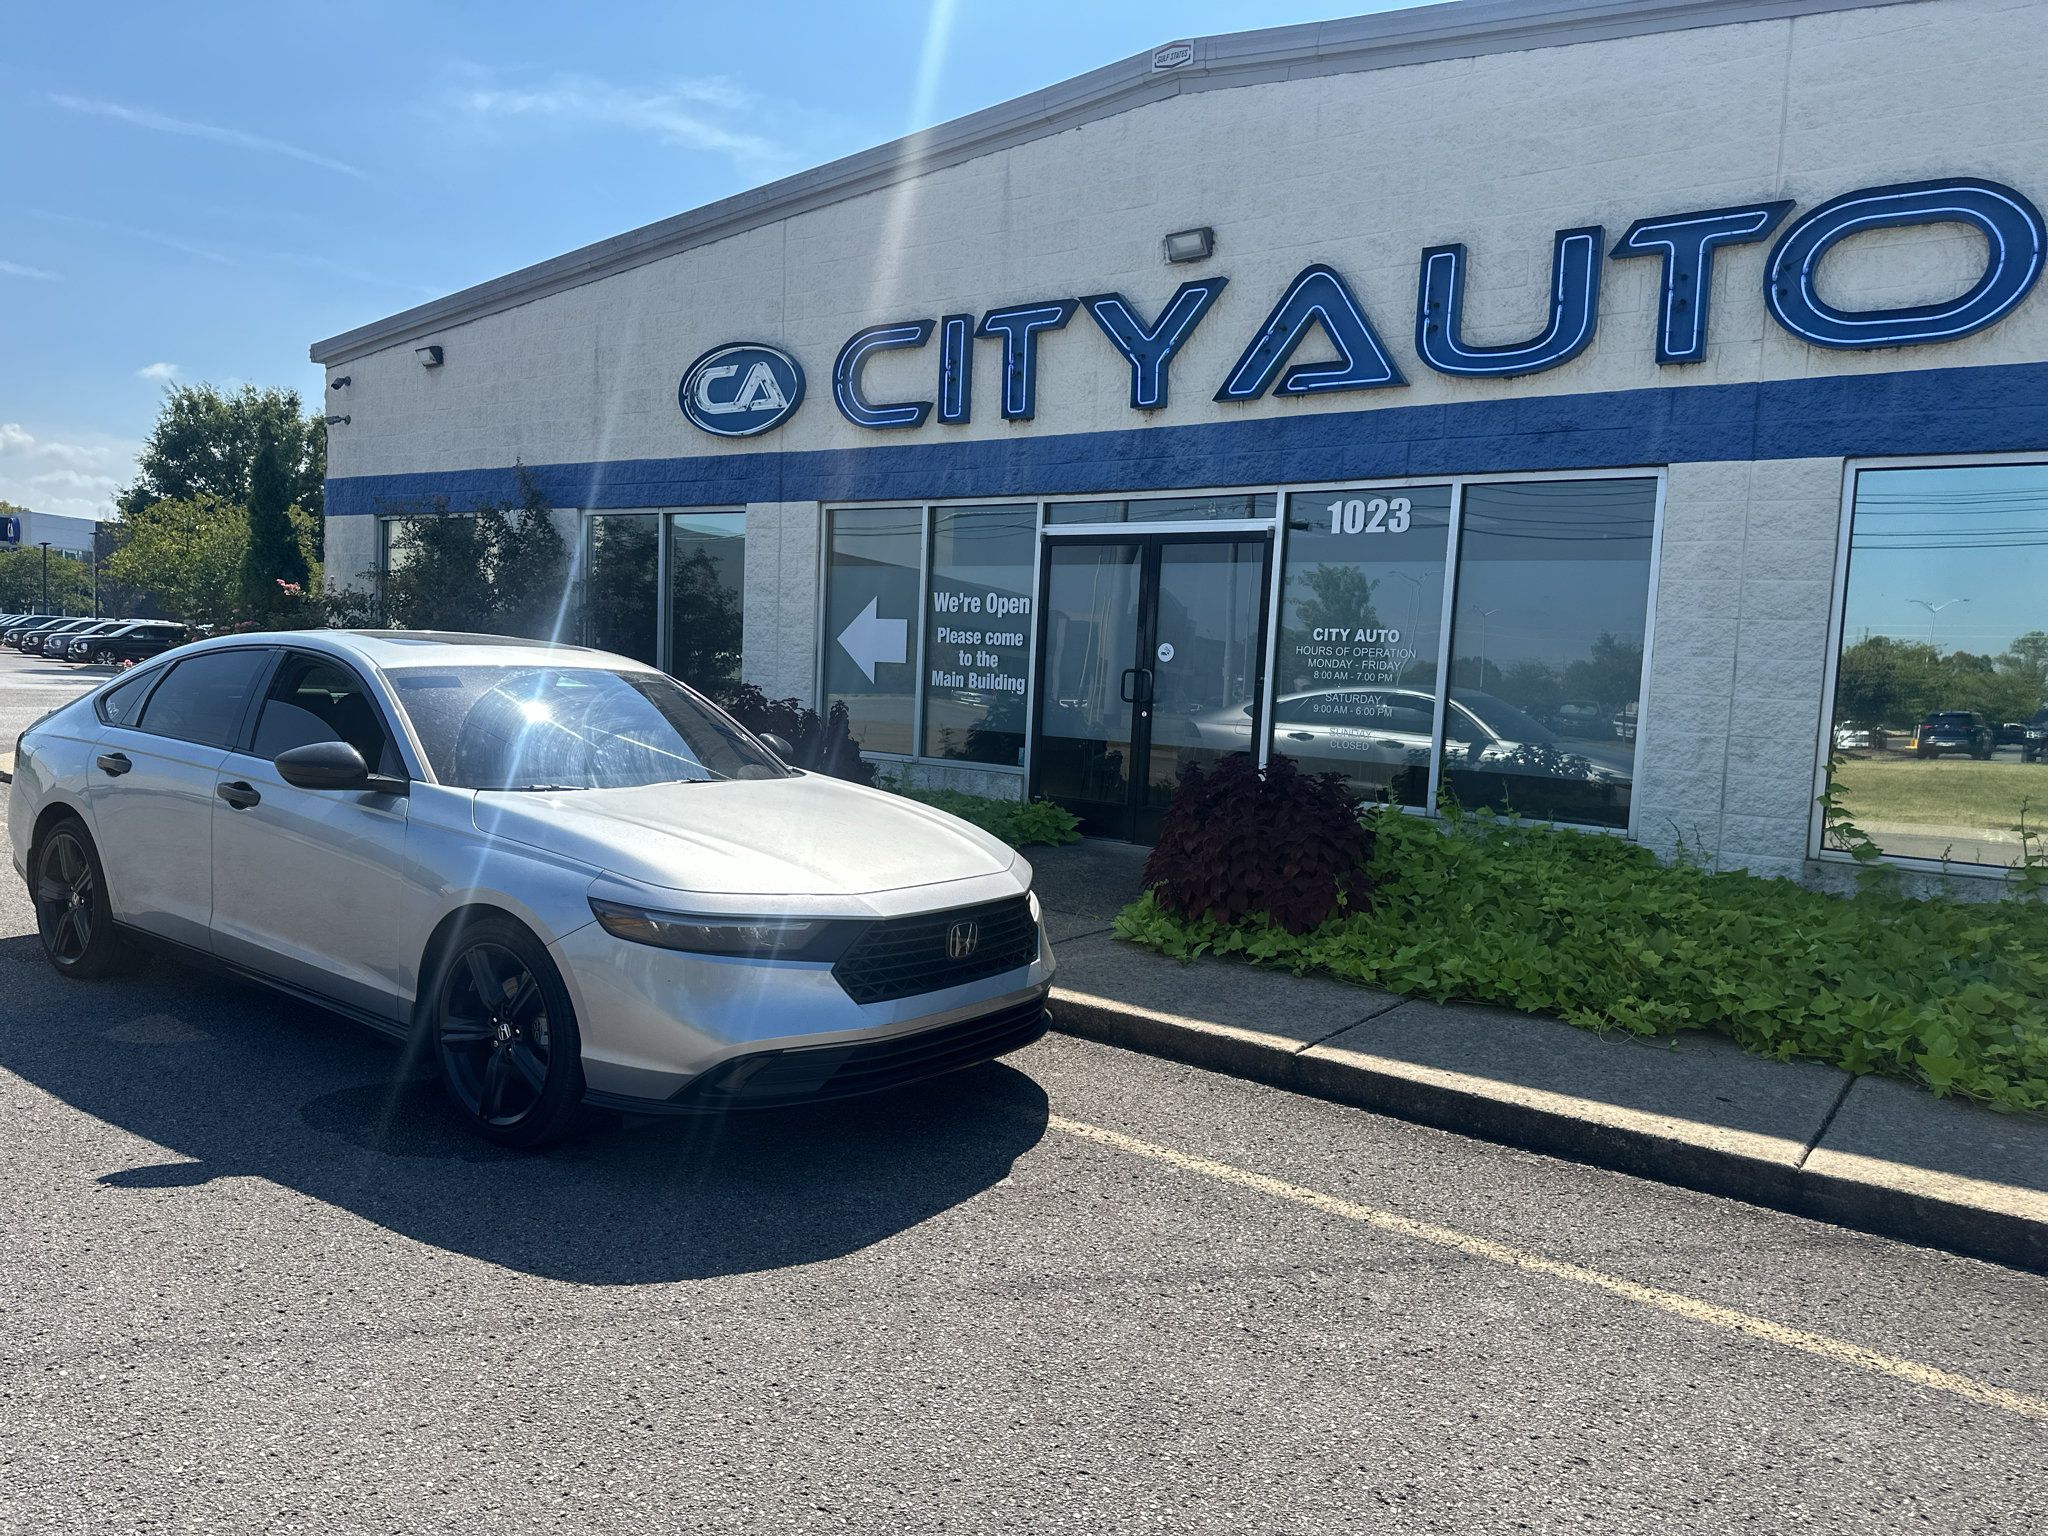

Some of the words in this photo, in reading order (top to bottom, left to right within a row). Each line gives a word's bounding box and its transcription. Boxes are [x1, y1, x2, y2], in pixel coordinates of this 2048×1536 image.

[832, 276, 1231, 430] CITY
[1213, 177, 2047, 403] AUTO
[694, 361, 788, 414] CA
[1327, 497, 1412, 535] 1023
[933, 592, 981, 614] We're
[986, 592, 1030, 618] Open
[937, 627, 982, 646] Please
[985, 630, 1024, 647] come
[1313, 627, 1351, 642] CITY
[1354, 628, 1400, 643] AUTO
[959, 650, 973, 667] to
[976, 650, 999, 668] the
[1295, 645, 1333, 656] HOURS
[1335, 646, 1351, 656] OF
[1352, 647, 1417, 659] OPERATION
[1307, 658, 1353, 669] MONDAY
[1361, 660, 1402, 671] FRIDAY
[931, 670, 964, 688] Main
[968, 672, 1026, 695] Building
[1313, 670, 1332, 680] 8:00
[1333, 671, 1348, 680] AM
[1356, 672, 1375, 682] 7:00
[1377, 673, 1393, 682] PM
[1325, 693, 1382, 705] SATURDAY
[1313, 704, 1332, 713] 9:00
[1333, 705, 1348, 714] AM
[1377, 708, 1393, 717] PM
[1330, 740, 1370, 751] CLOSED
